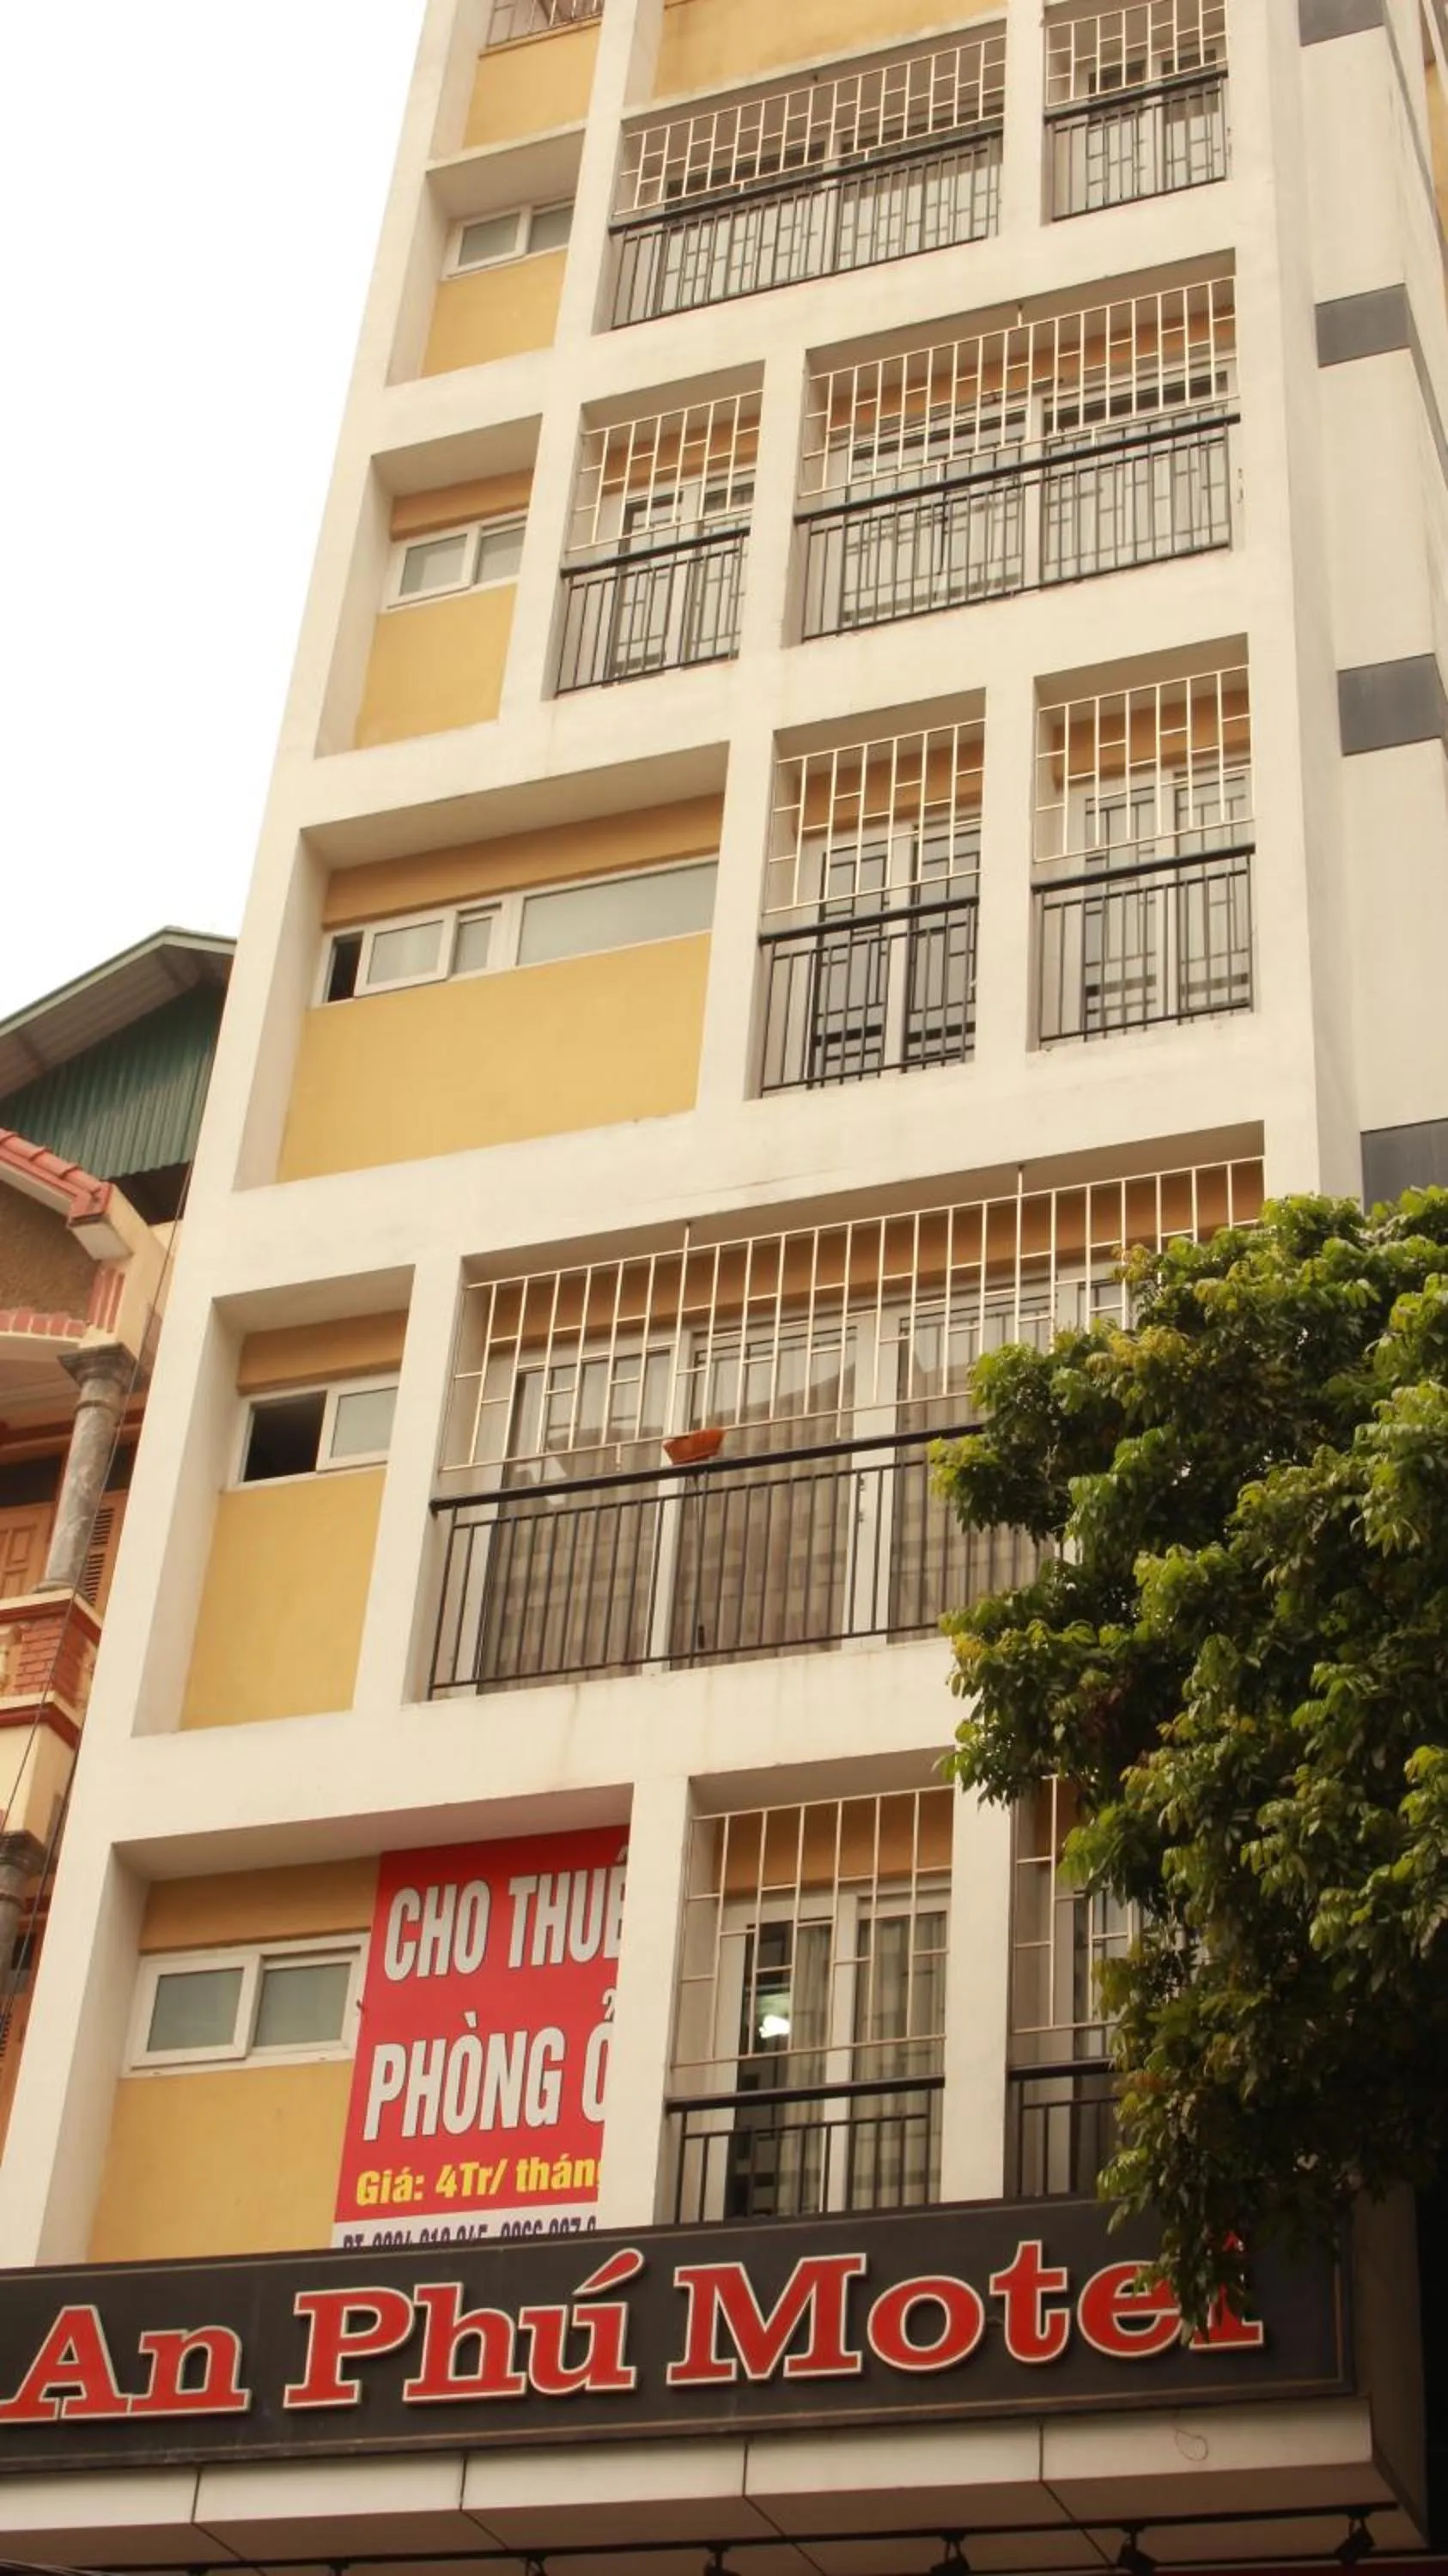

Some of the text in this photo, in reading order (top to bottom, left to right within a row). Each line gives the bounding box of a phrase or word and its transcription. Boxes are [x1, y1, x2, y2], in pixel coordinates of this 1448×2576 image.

[384, 1879, 491, 1982] CHO
[362, 2010, 566, 2142] PHÒNG
[356, 2165, 424, 2207] Giá:
[515, 2152, 599, 2193] thán
[0, 2304, 252, 2424] An
[283, 2247, 645, 2409] Phú
